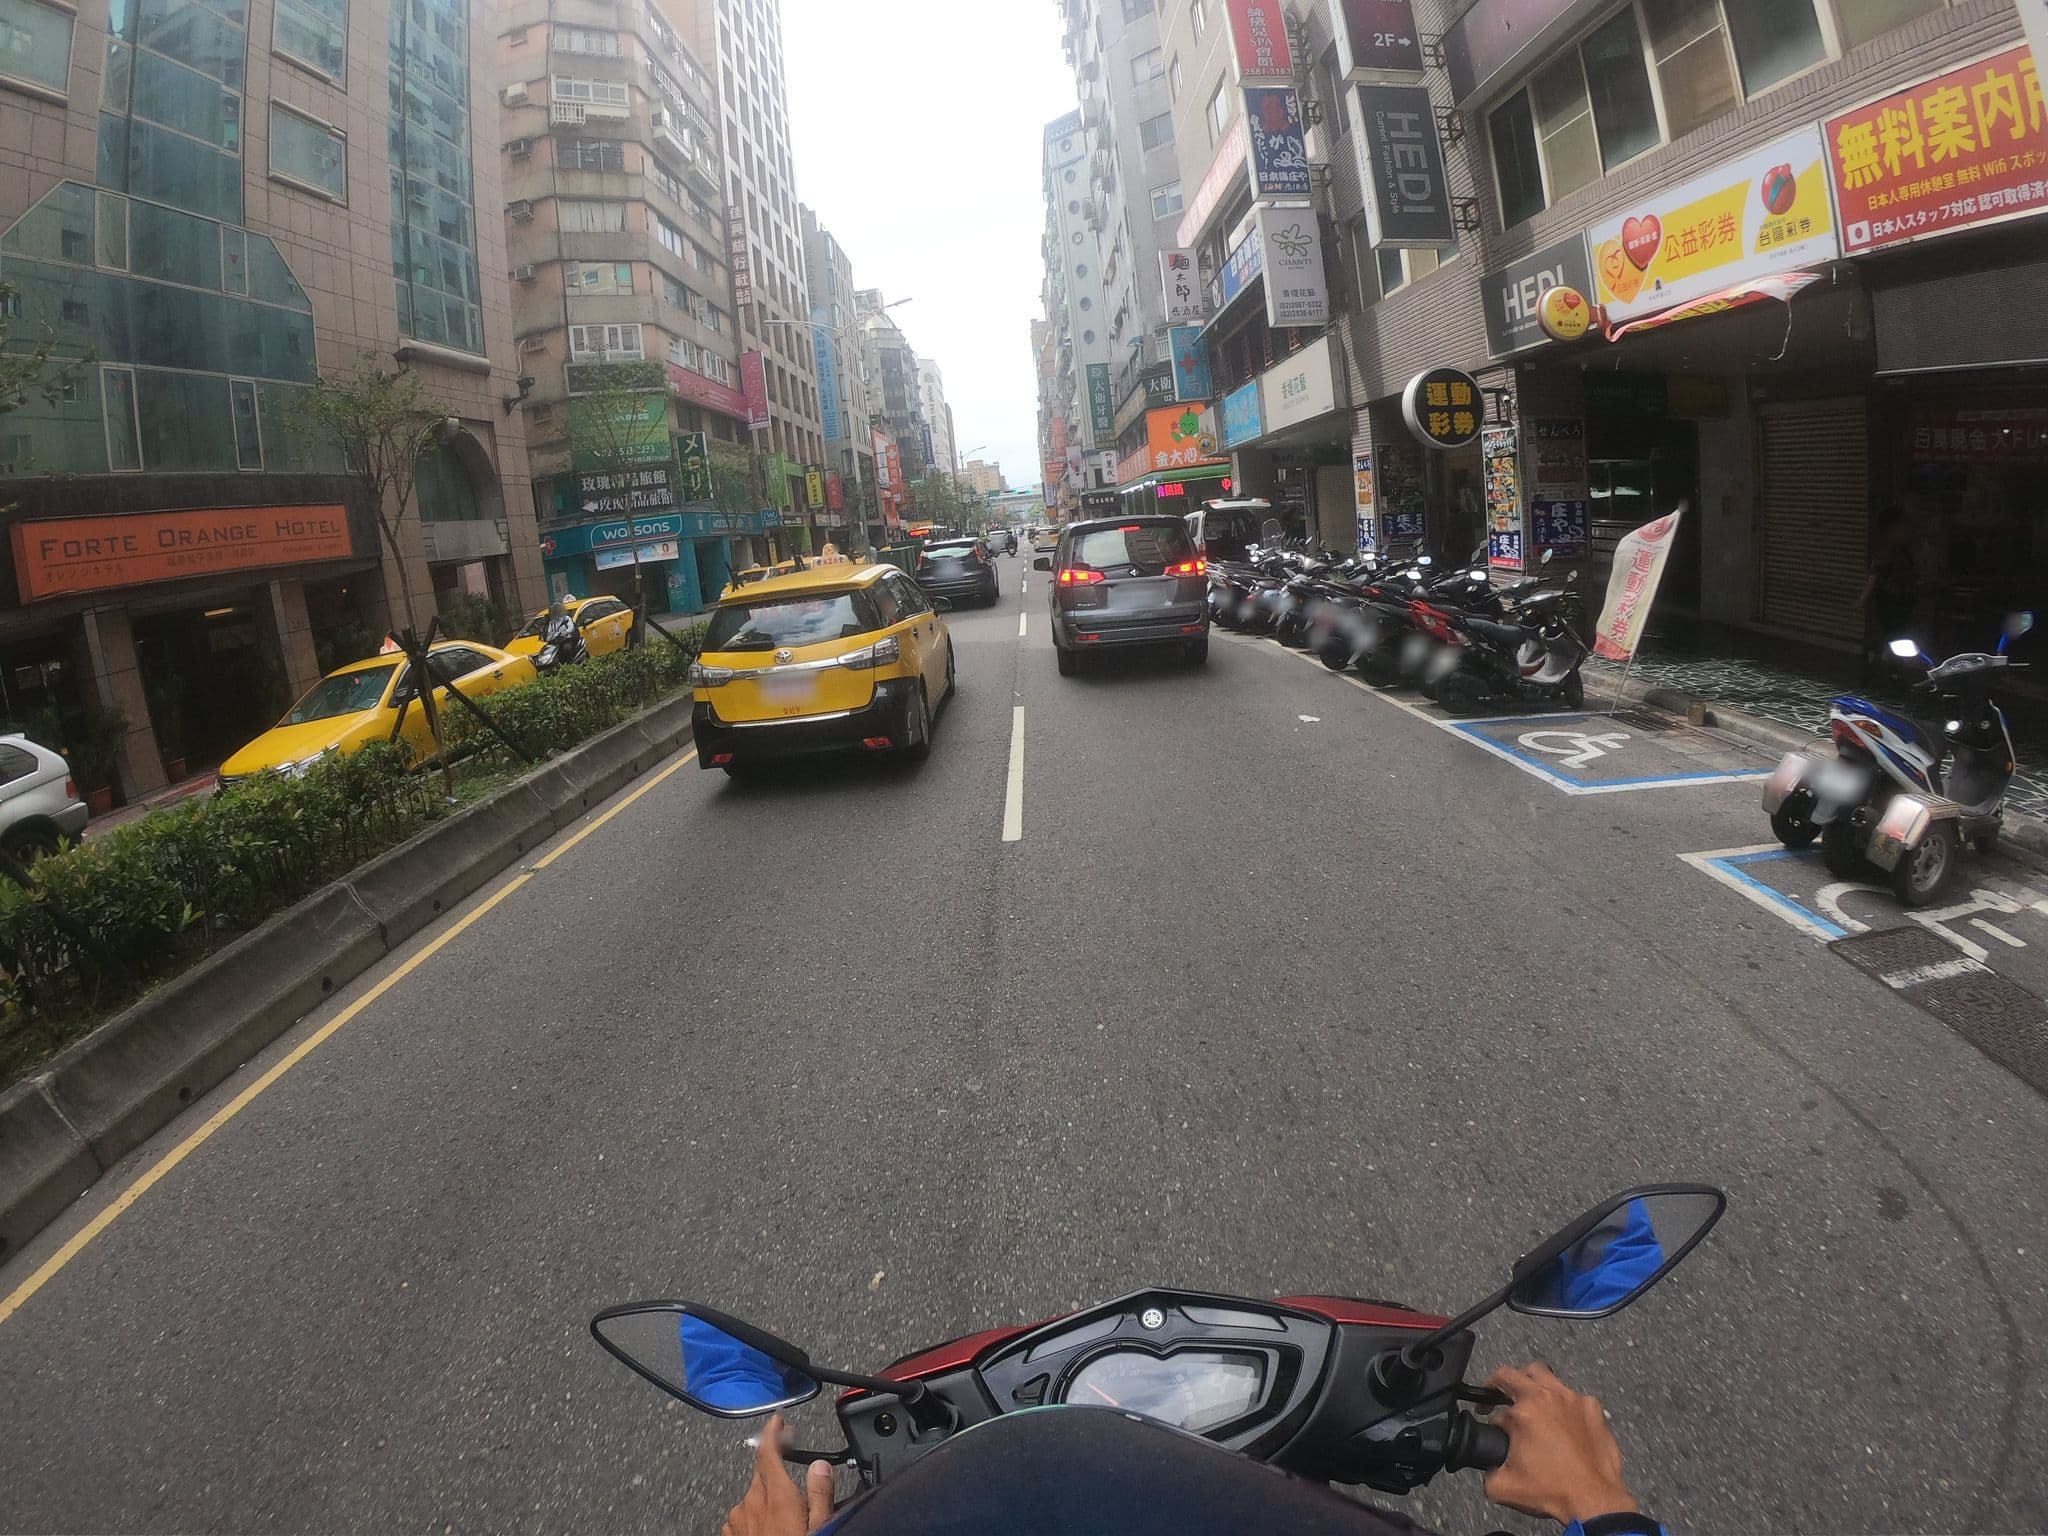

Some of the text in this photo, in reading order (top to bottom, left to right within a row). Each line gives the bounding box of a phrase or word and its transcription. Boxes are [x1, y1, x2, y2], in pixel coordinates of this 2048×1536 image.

[1373, 32, 1395, 47] 2F
[1375, 110, 1387, 142] Current
[1380, 144, 1392, 181] Fashion
[1387, 111, 1436, 214] HEDI
[1956, 164, 1981, 186] 無料
[1983, 157, 2008, 177] Wifi
[1390, 191, 1400, 216] Style
[1873, 198, 1976, 238] 日本人スタッフ対応
[1664, 213, 1737, 263] 公益彩券
[1171, 304, 1201, 318] 居酒屋
[1426, 382, 1472, 407] 運動
[1430, 411, 1474, 438] 彩券
[40, 535, 138, 561] FORTE
[158, 524, 258, 548] ORANGE
[275, 520, 340, 537] HOTEL
